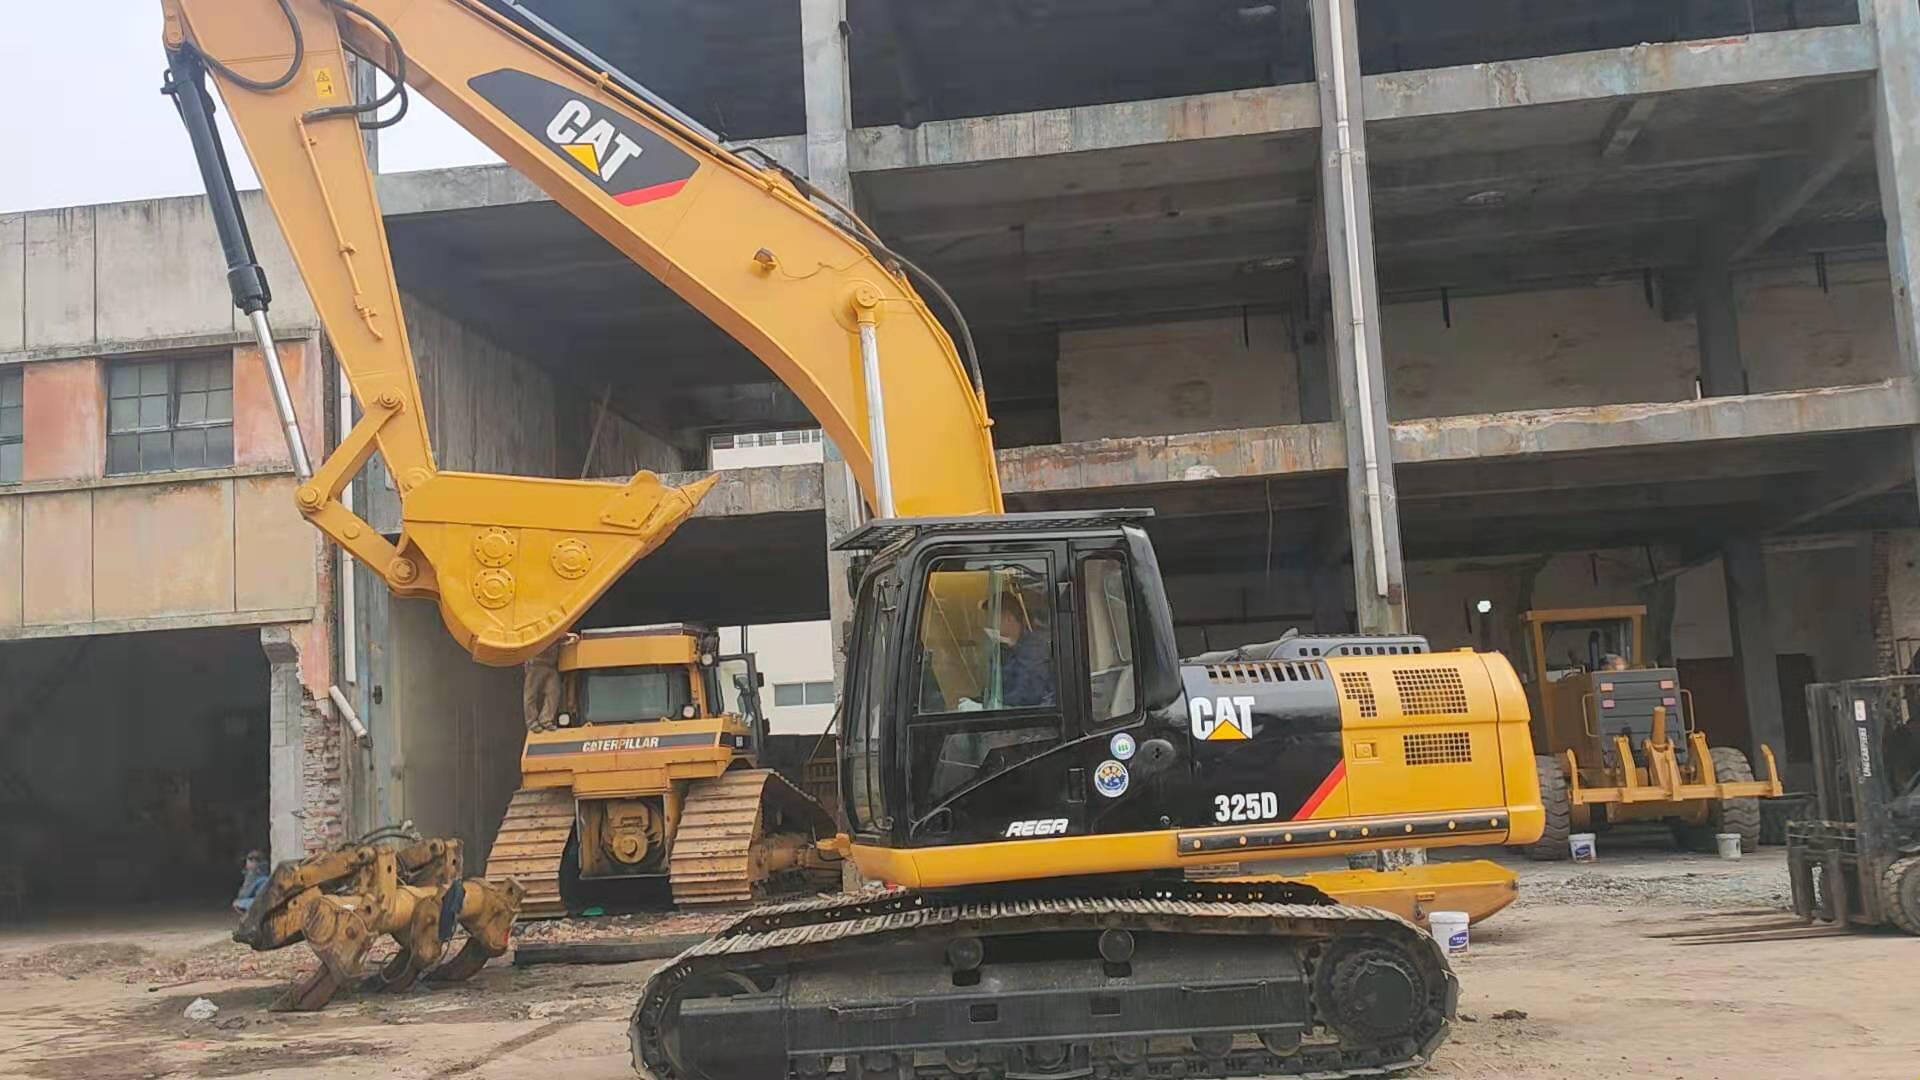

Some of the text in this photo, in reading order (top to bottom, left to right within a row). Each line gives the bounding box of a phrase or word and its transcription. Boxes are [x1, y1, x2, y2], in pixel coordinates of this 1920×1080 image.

[546, 99, 643, 182] CAT
[1190, 696, 1255, 740] CAT
[582, 736, 660, 752] CATERPILLAR
[1214, 791, 1278, 822] 325D
[1005, 818, 1069, 837] REGA
